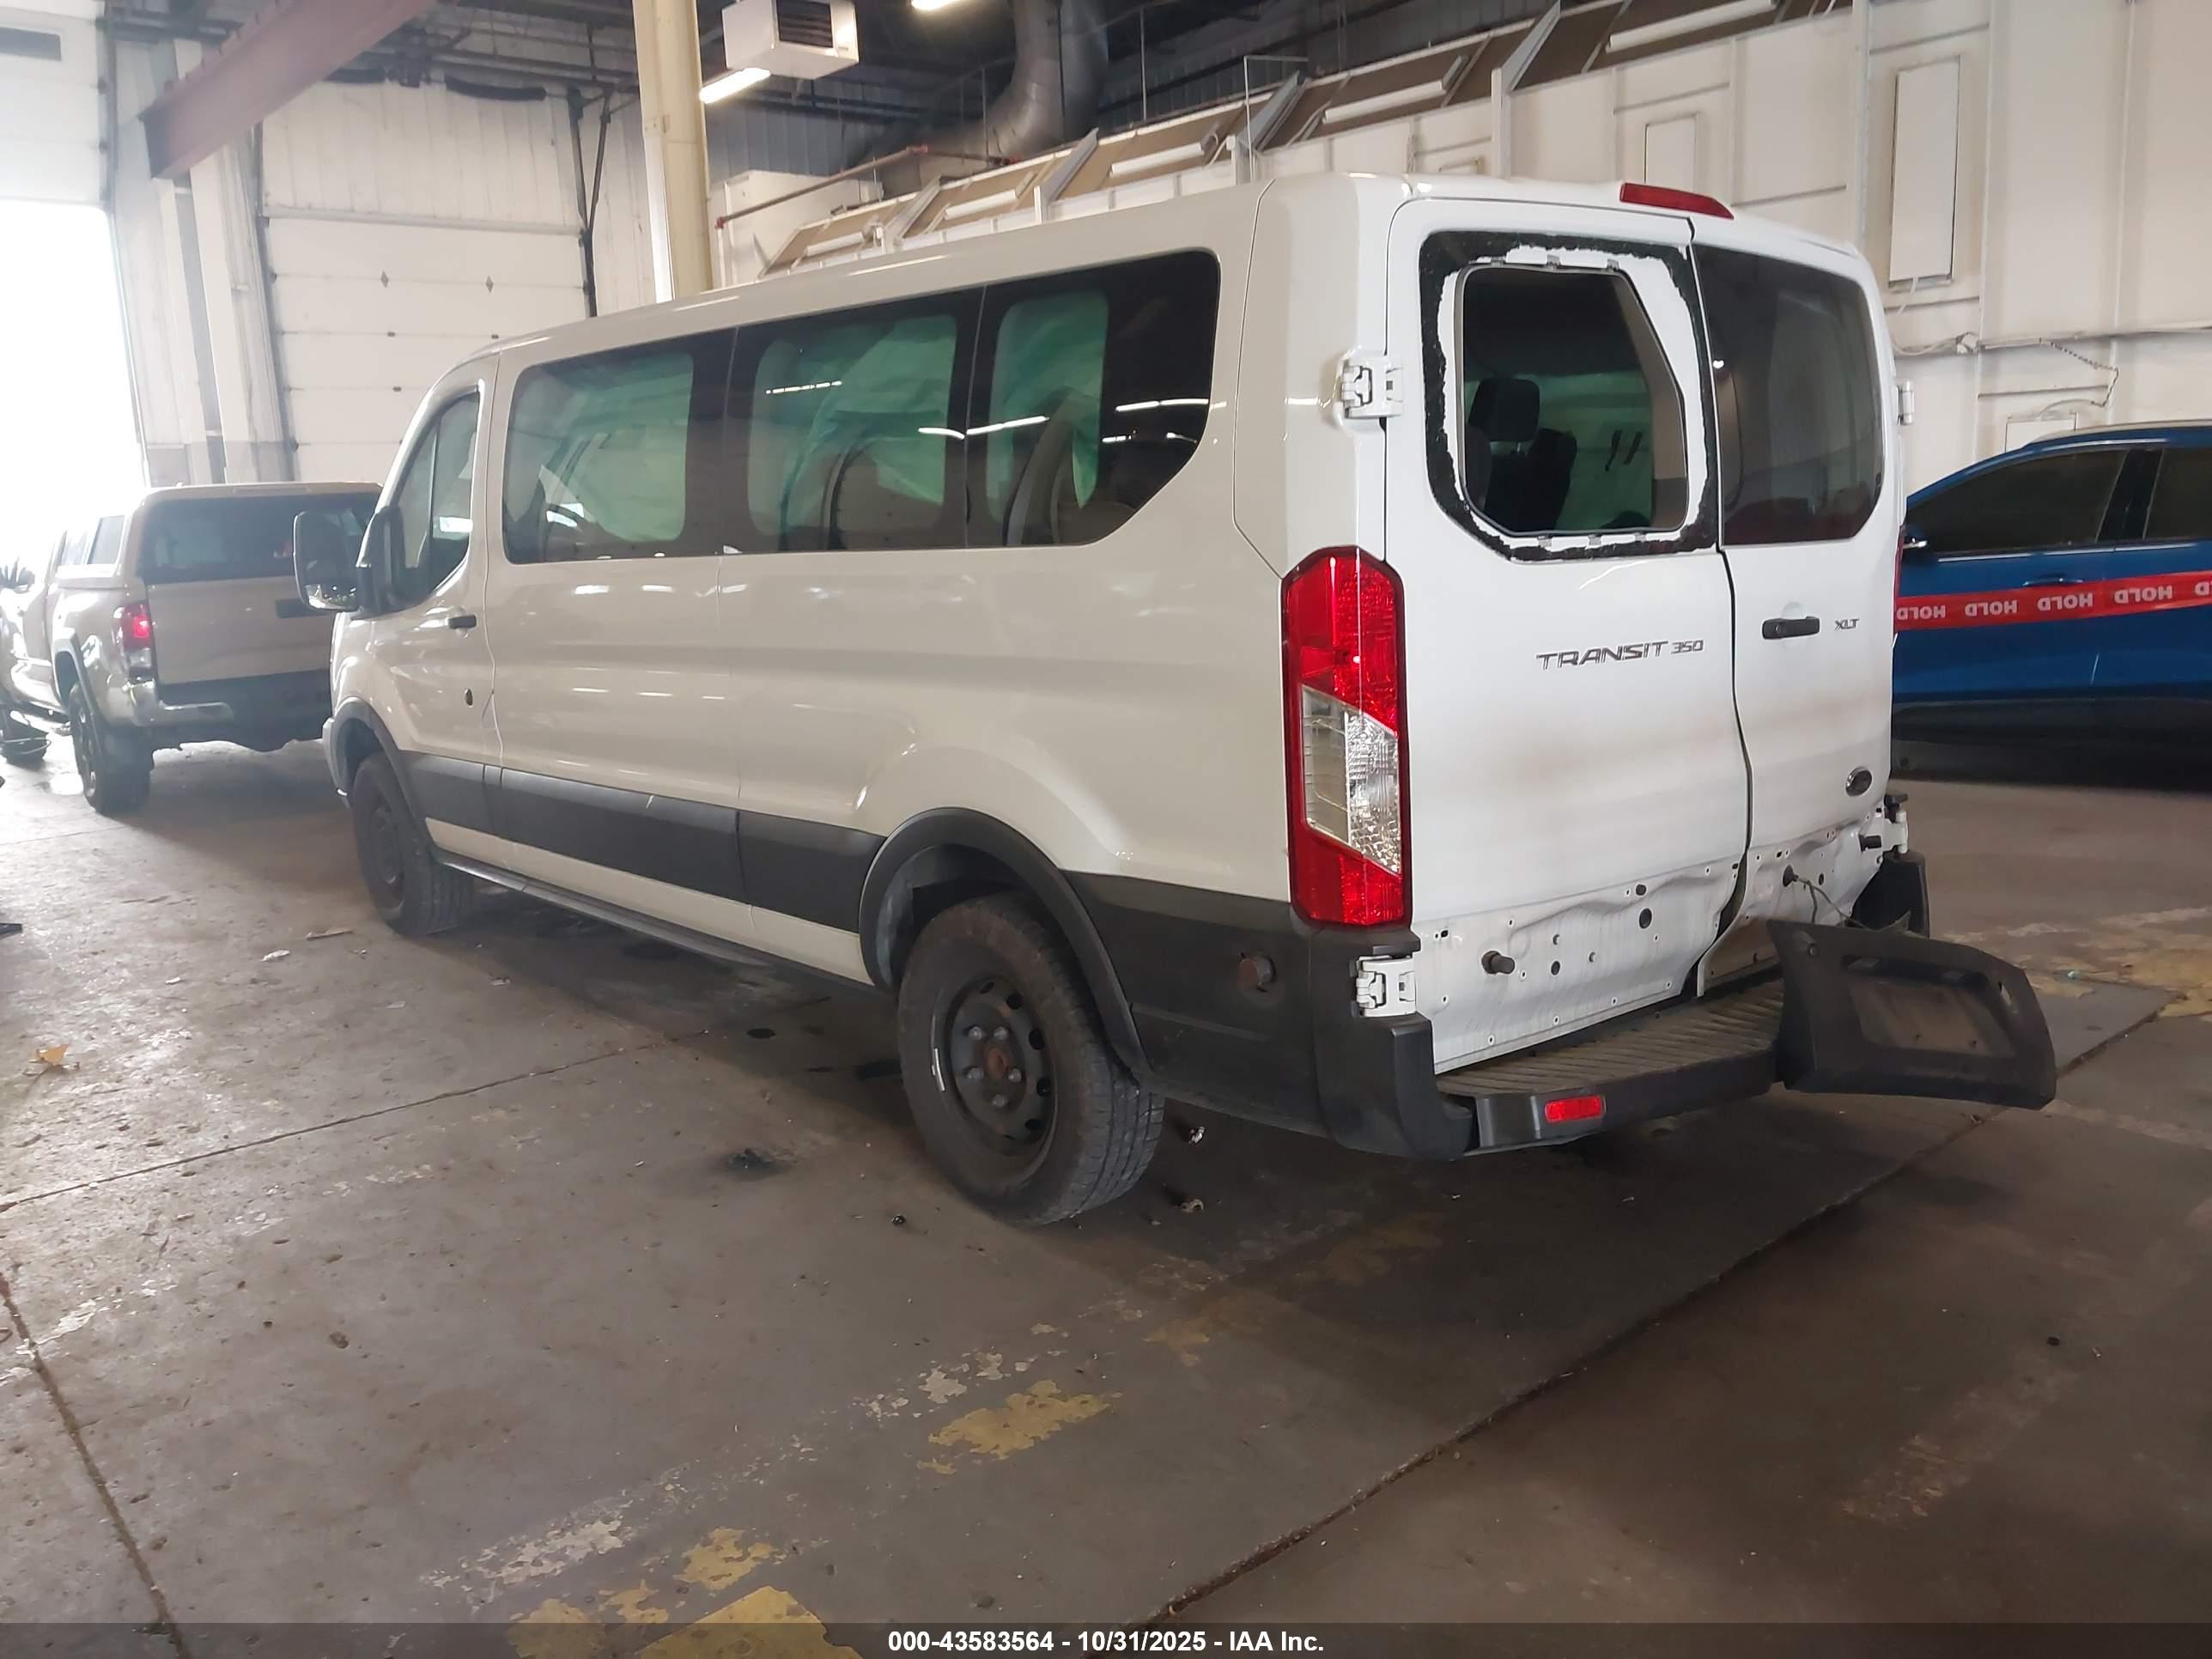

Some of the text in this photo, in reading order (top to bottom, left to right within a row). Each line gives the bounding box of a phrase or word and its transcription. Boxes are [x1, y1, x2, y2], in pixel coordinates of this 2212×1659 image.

[1896, 585, 2172, 620] HOLD HOLD HOLD HOLD
[1834, 618, 1860, 631] XLT
[1536, 639, 1704, 670] TRANSIT 350
